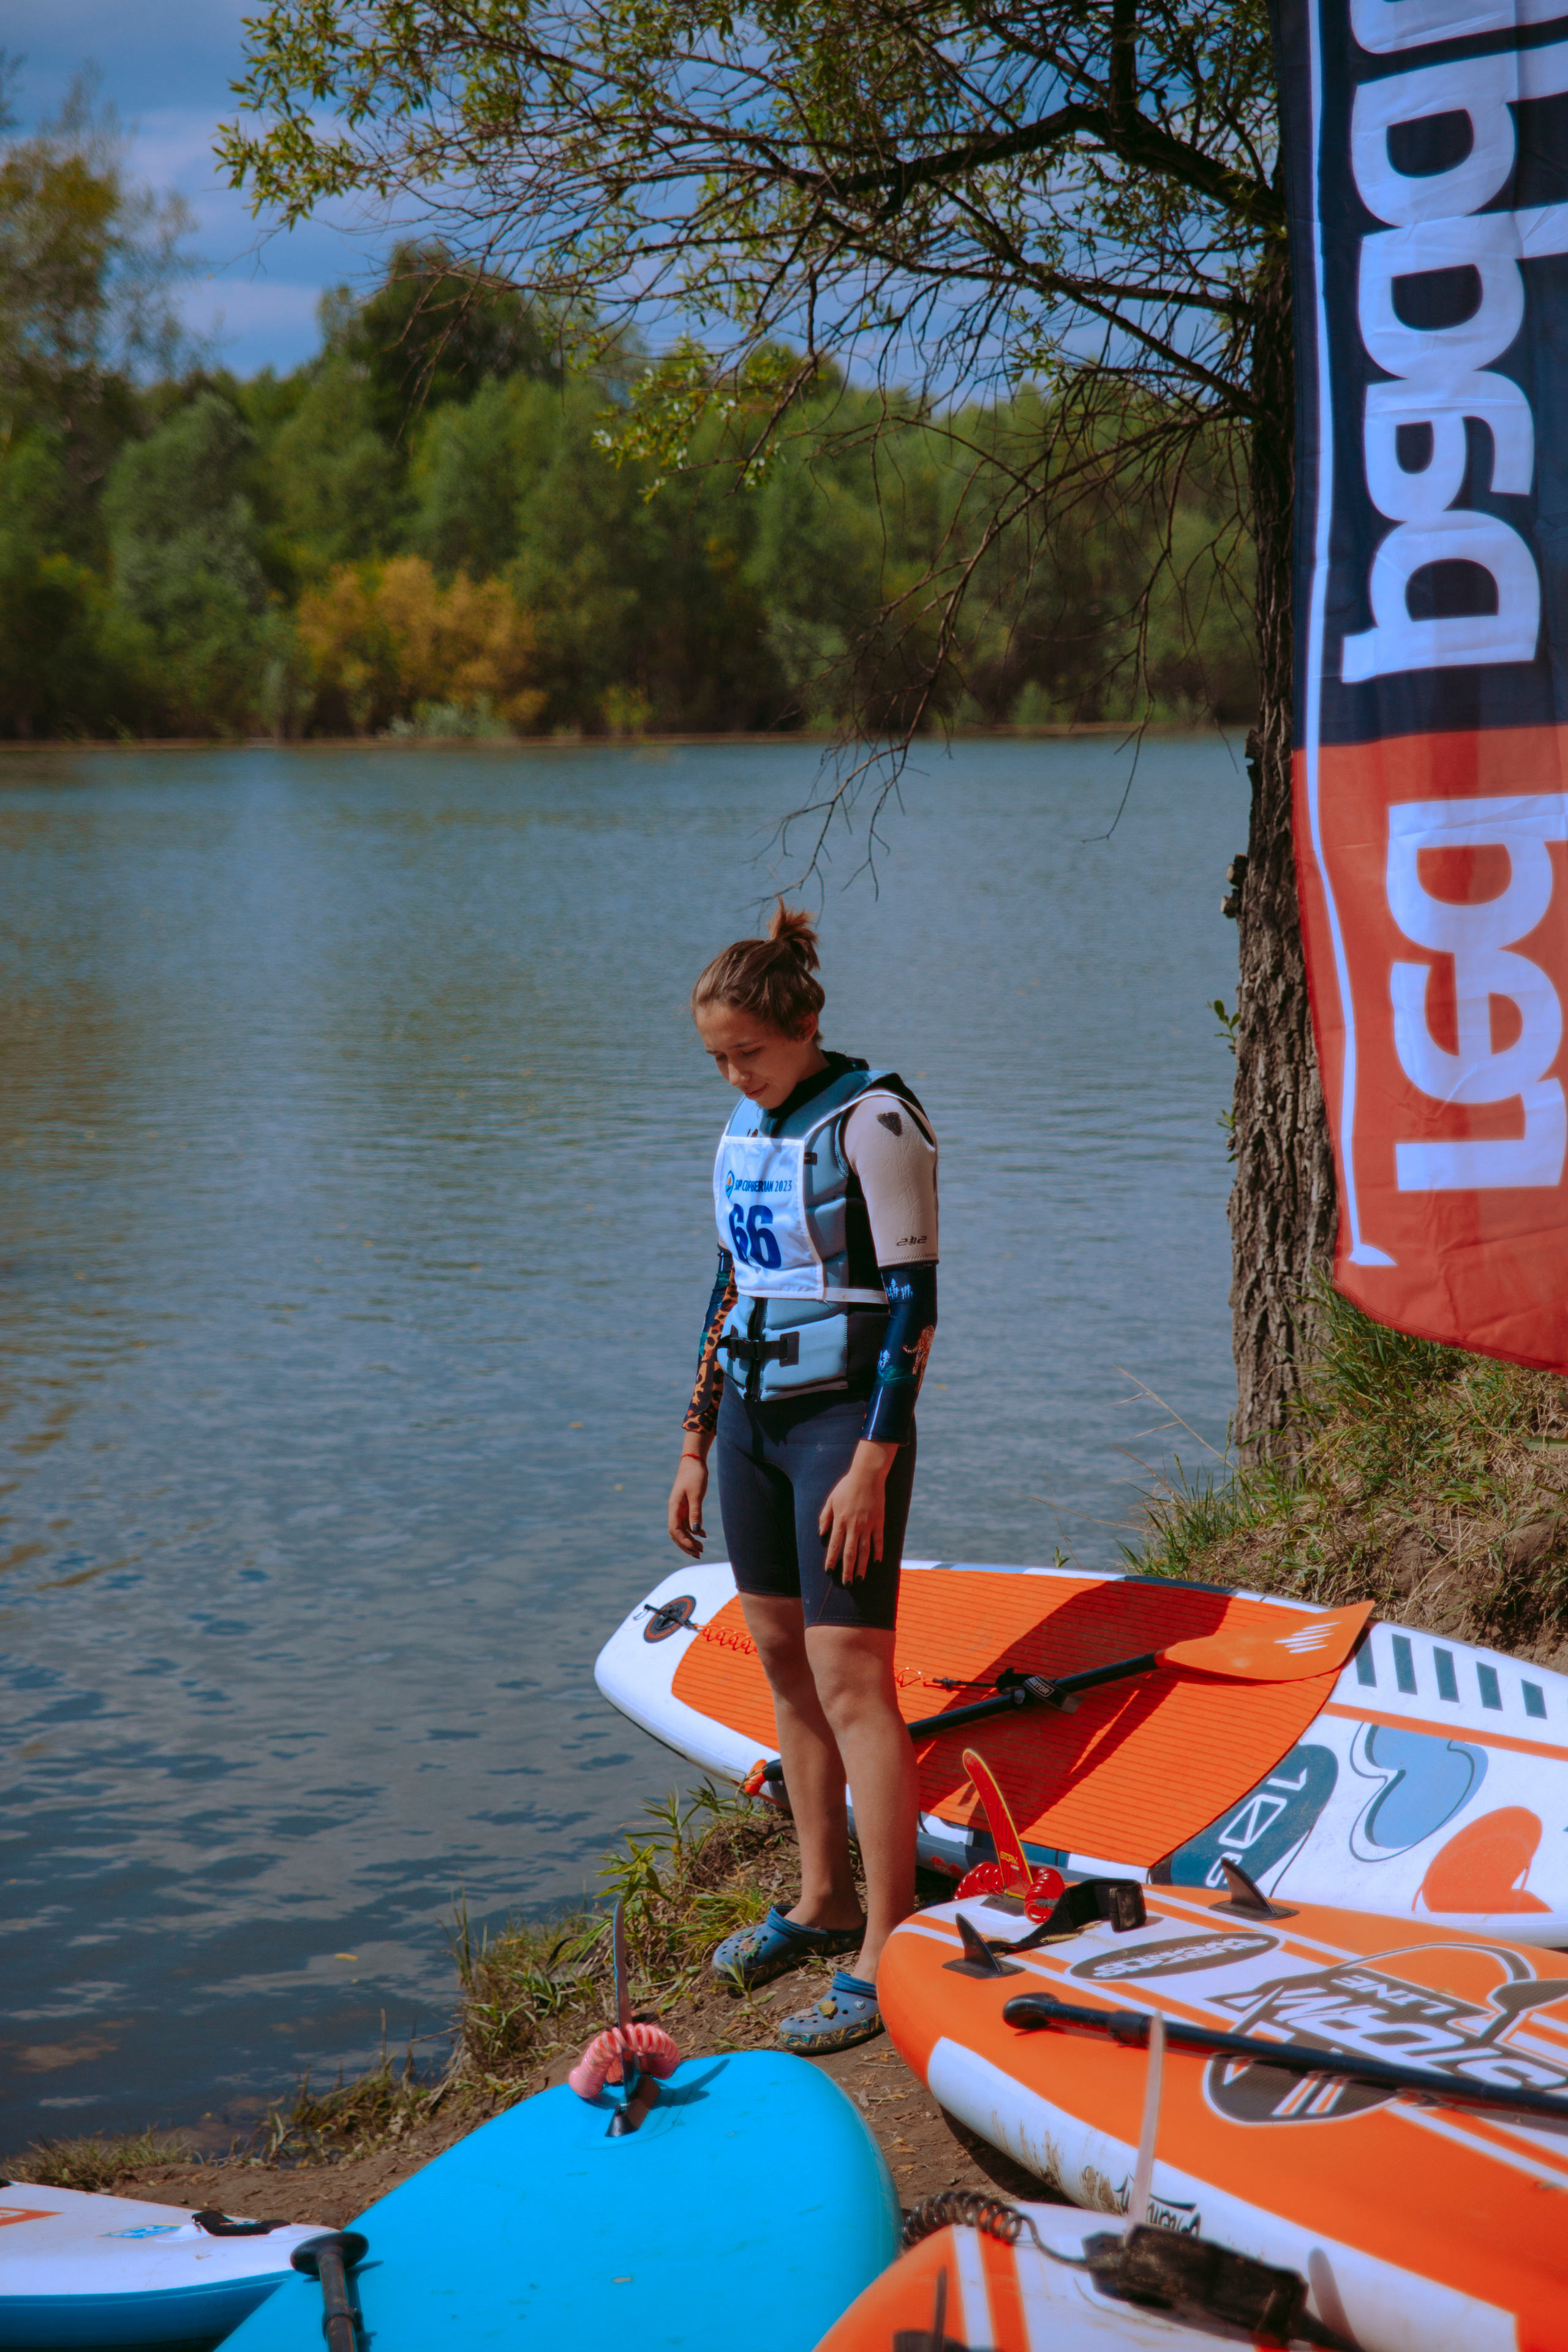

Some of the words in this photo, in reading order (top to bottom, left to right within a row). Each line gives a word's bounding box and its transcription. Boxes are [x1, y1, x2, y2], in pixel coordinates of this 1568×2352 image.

[774, 1180, 793, 1192] 2023
[729, 1204, 782, 1268] 66
[1330, 1974, 1456, 2015] LINE
